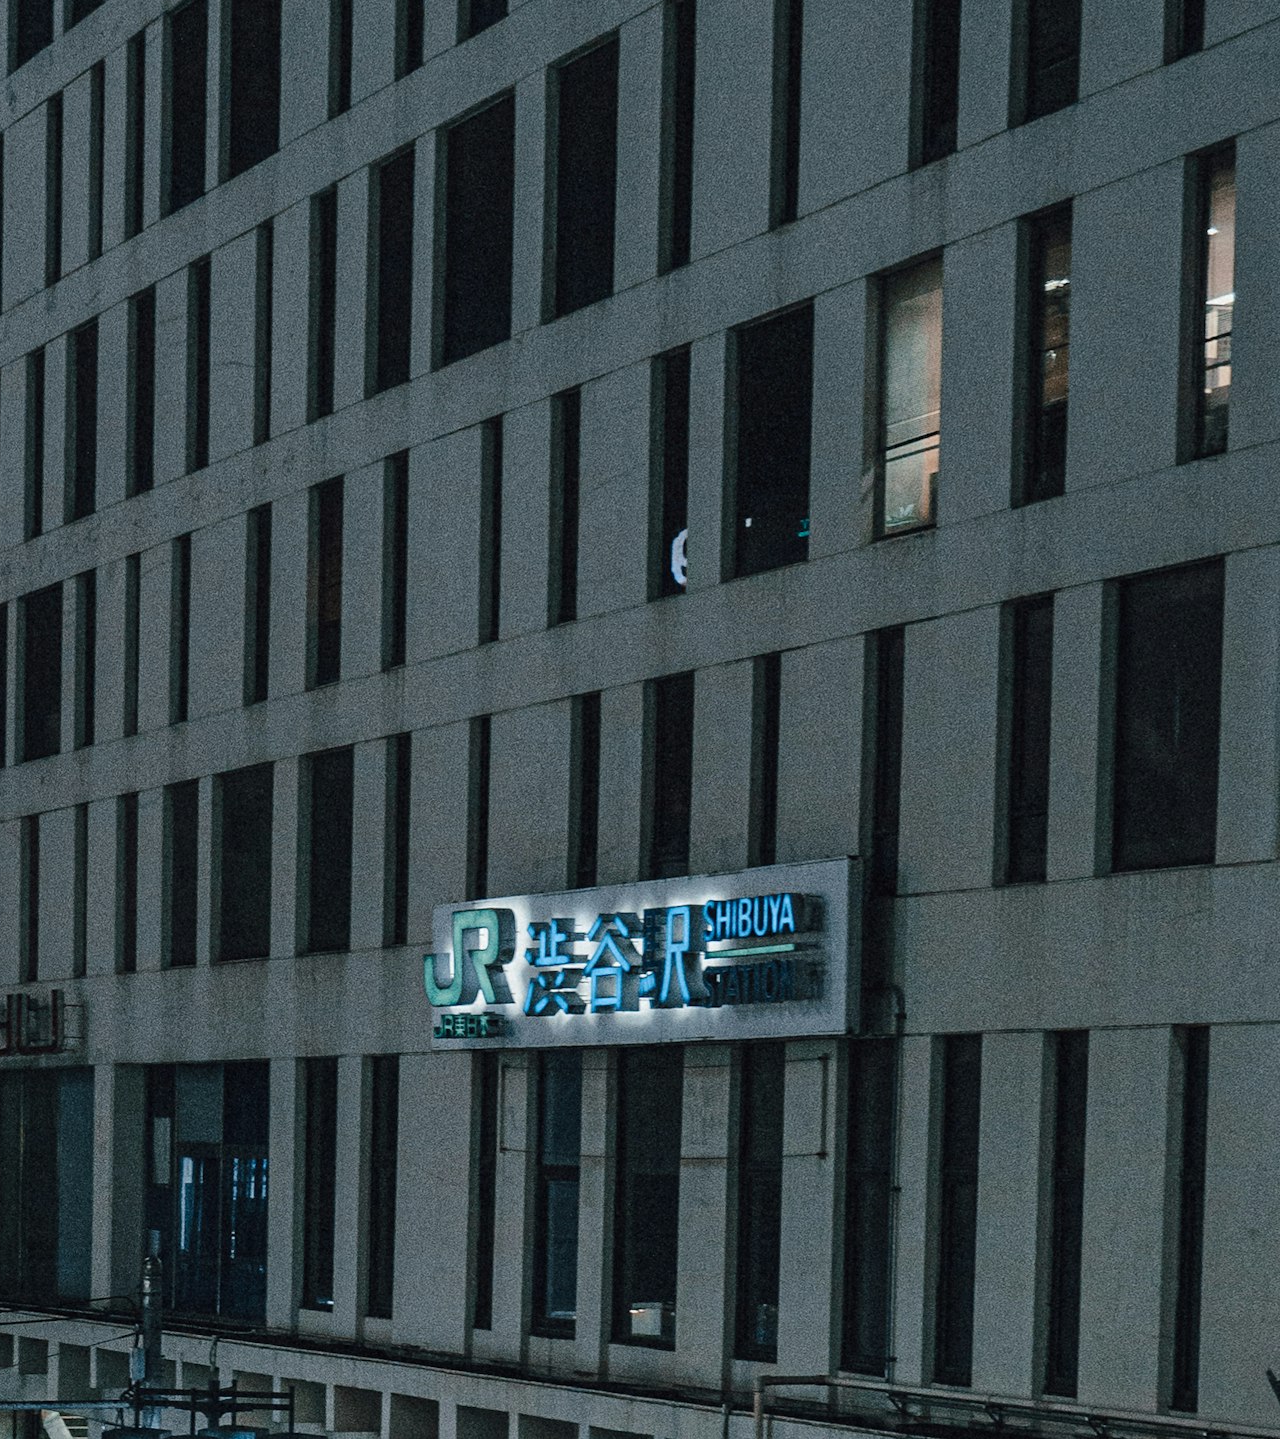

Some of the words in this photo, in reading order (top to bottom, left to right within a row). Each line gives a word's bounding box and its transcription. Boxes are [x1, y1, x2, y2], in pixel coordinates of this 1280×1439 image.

[423, 908, 497, 1006] JR
[523, 905, 691, 1016] 渋谷駅
[702, 893, 796, 942] SHIBUYA
[704, 960, 796, 1008] STATION
[434, 1012, 490, 1039] JR東日本
